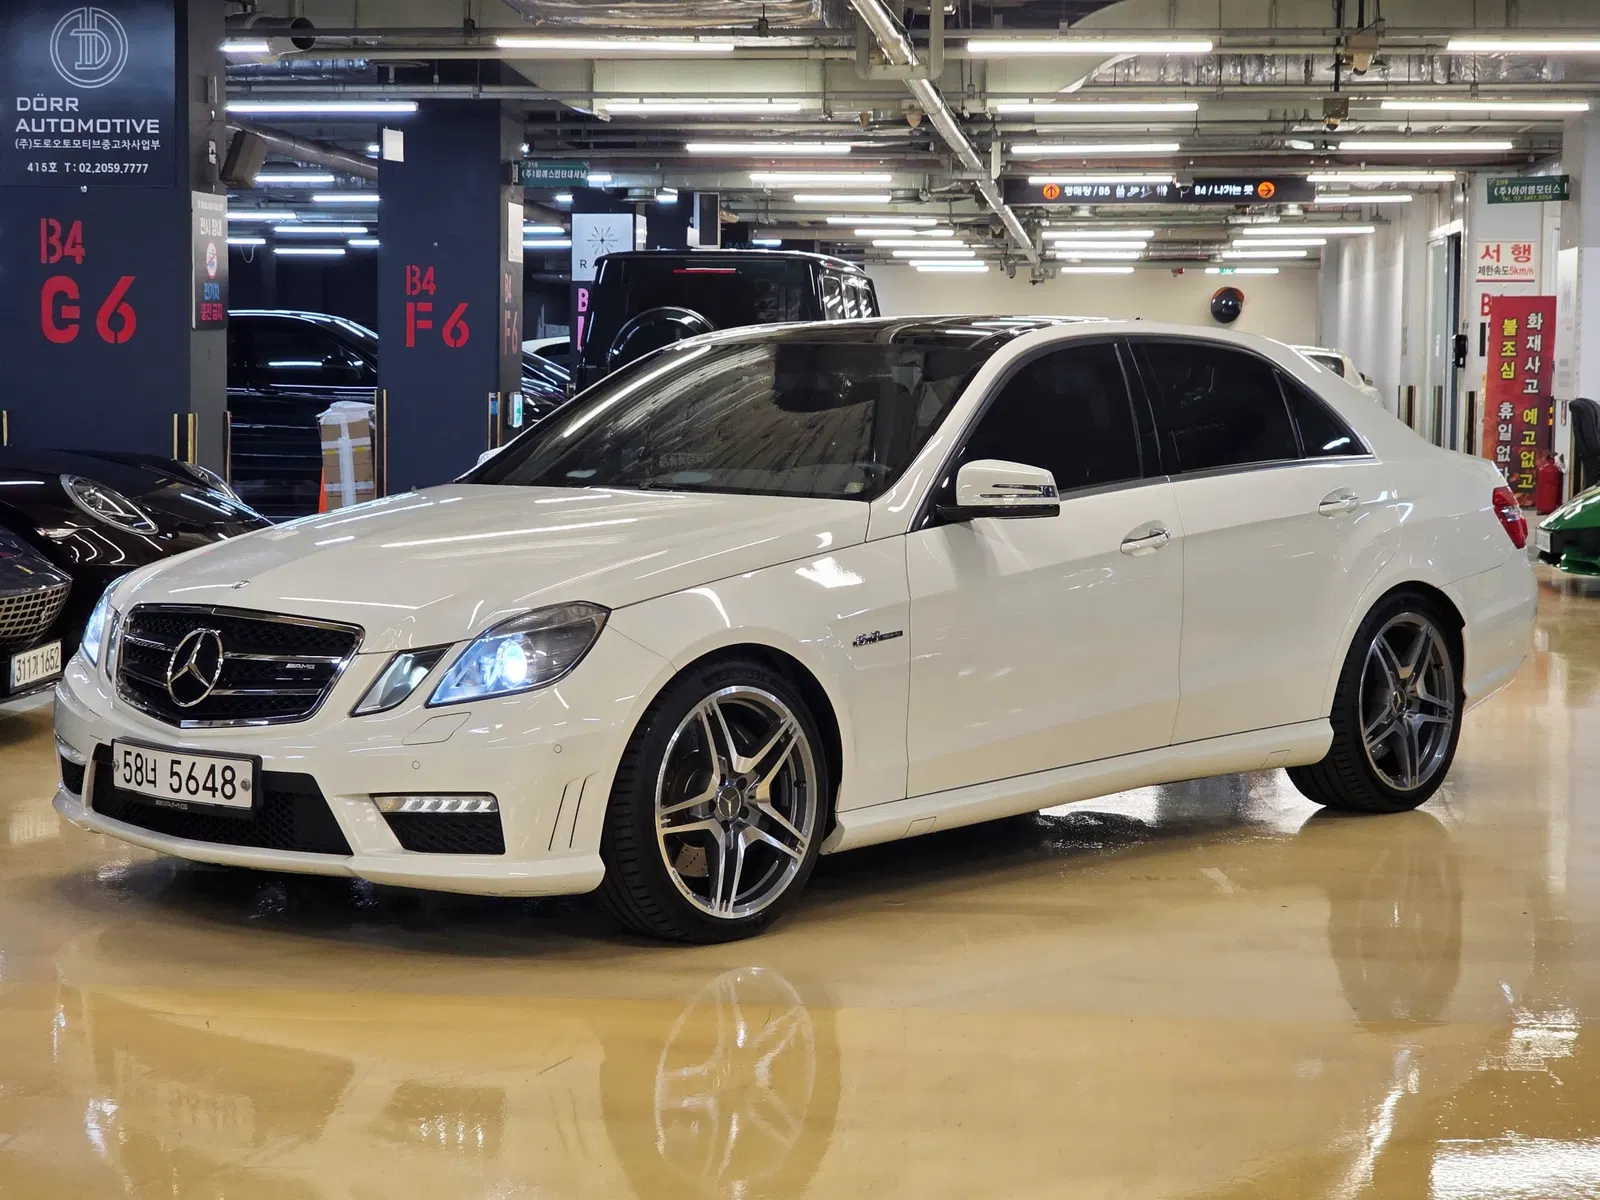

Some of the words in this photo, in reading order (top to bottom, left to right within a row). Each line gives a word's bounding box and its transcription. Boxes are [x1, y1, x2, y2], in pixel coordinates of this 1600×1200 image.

[16, 93, 79, 112] DÖRR
[15, 118, 160, 134] AUTOMOTIVE
[14, 138, 161, 151] (주)도로오토모티브중고차사업부
[27, 162, 58, 173] 415호
[40, 217, 86, 264] B4
[405, 264, 437, 295] B4
[1480, 293, 1492, 317] B
[1500, 318, 1518, 380] 불조심
[1522, 312, 1543, 394] 화재사고
[123, 750, 157, 788] 58너
[169, 759, 237, 800] 5648
